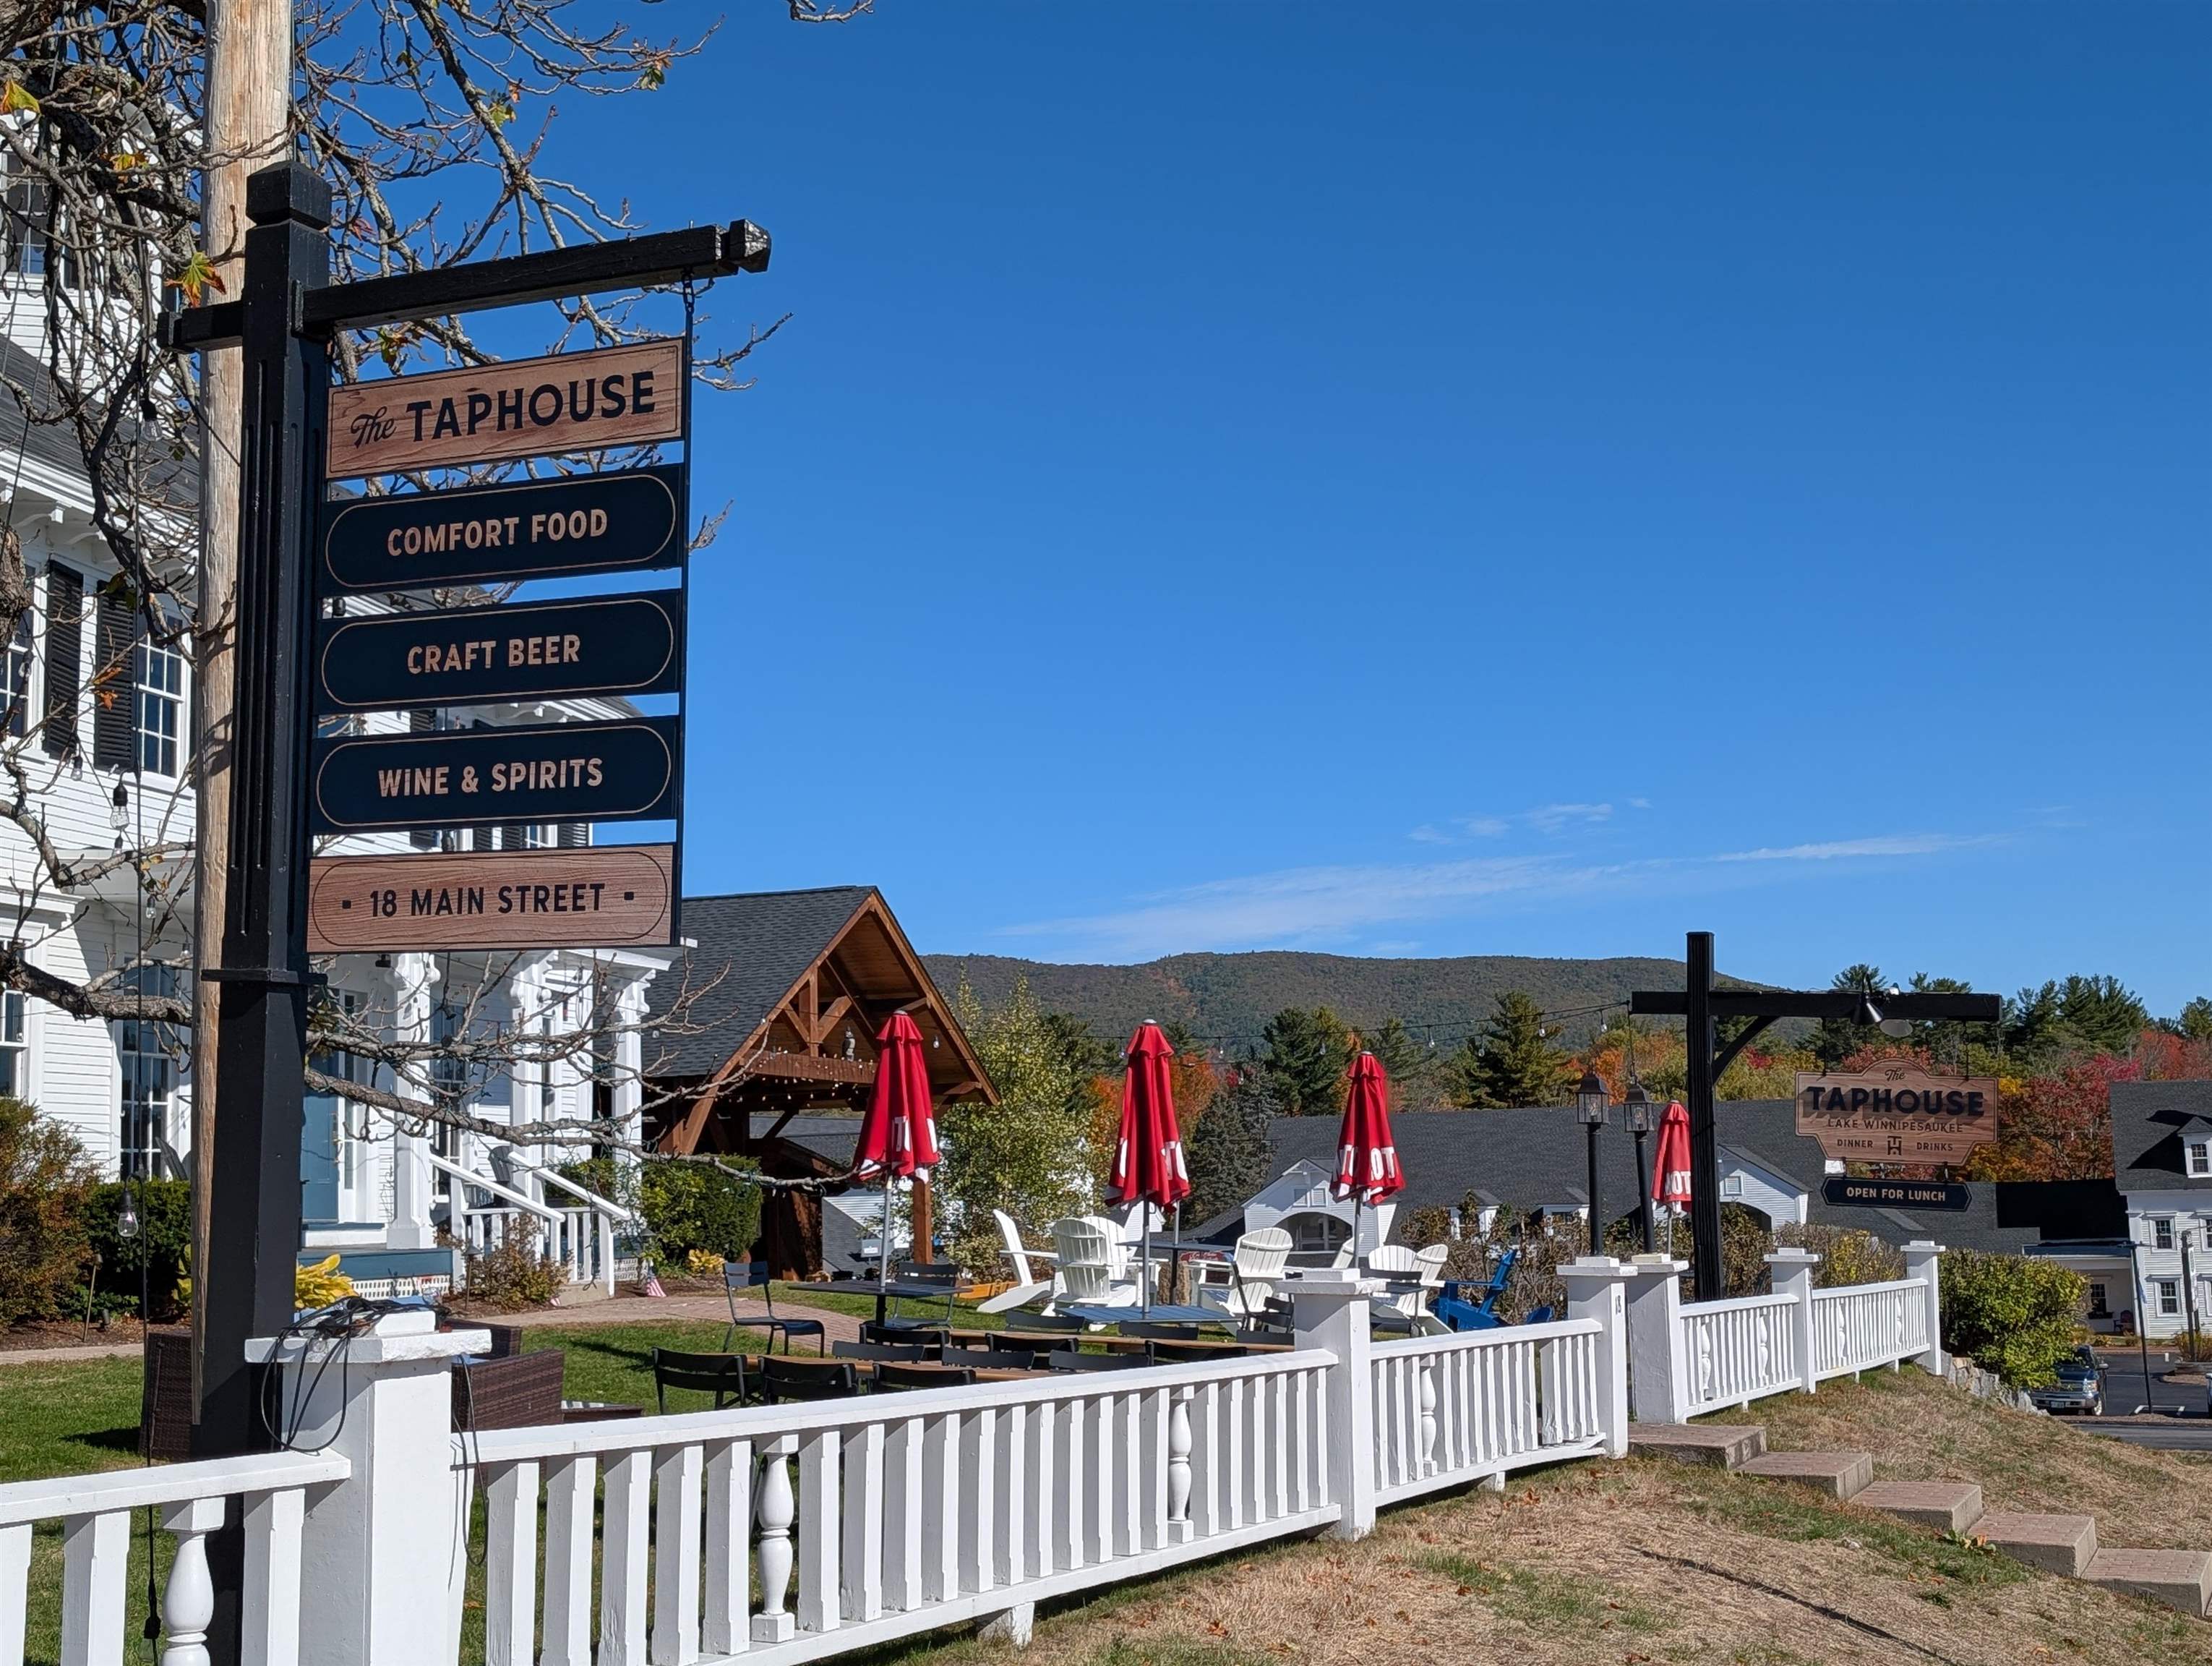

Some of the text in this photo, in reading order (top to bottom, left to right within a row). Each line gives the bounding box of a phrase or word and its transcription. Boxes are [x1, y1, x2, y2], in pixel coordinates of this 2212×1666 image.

[350, 370, 656, 450] The TAPHOUSE
[387, 508, 608, 557] COMFORT FOOD
[407, 634, 580, 675] CRAFT BEER
[378, 758, 603, 798] WINE & SPIRITS
[369, 883, 606, 918] 18 MAIN STREET
[1885, 1067, 1906, 1082] The
[1806, 1086, 1985, 1116] TAPHOUSE
[1827, 1119, 1963, 1133] LAKE WINNIPESAUKEE
[1837, 1139, 1874, 1148] DINNER
[1916, 1142, 1953, 1151] DRINKS
[1846, 1187, 1946, 1202] OPEN FOR LUNCH
[1615, 1294, 1622, 1315] 18
